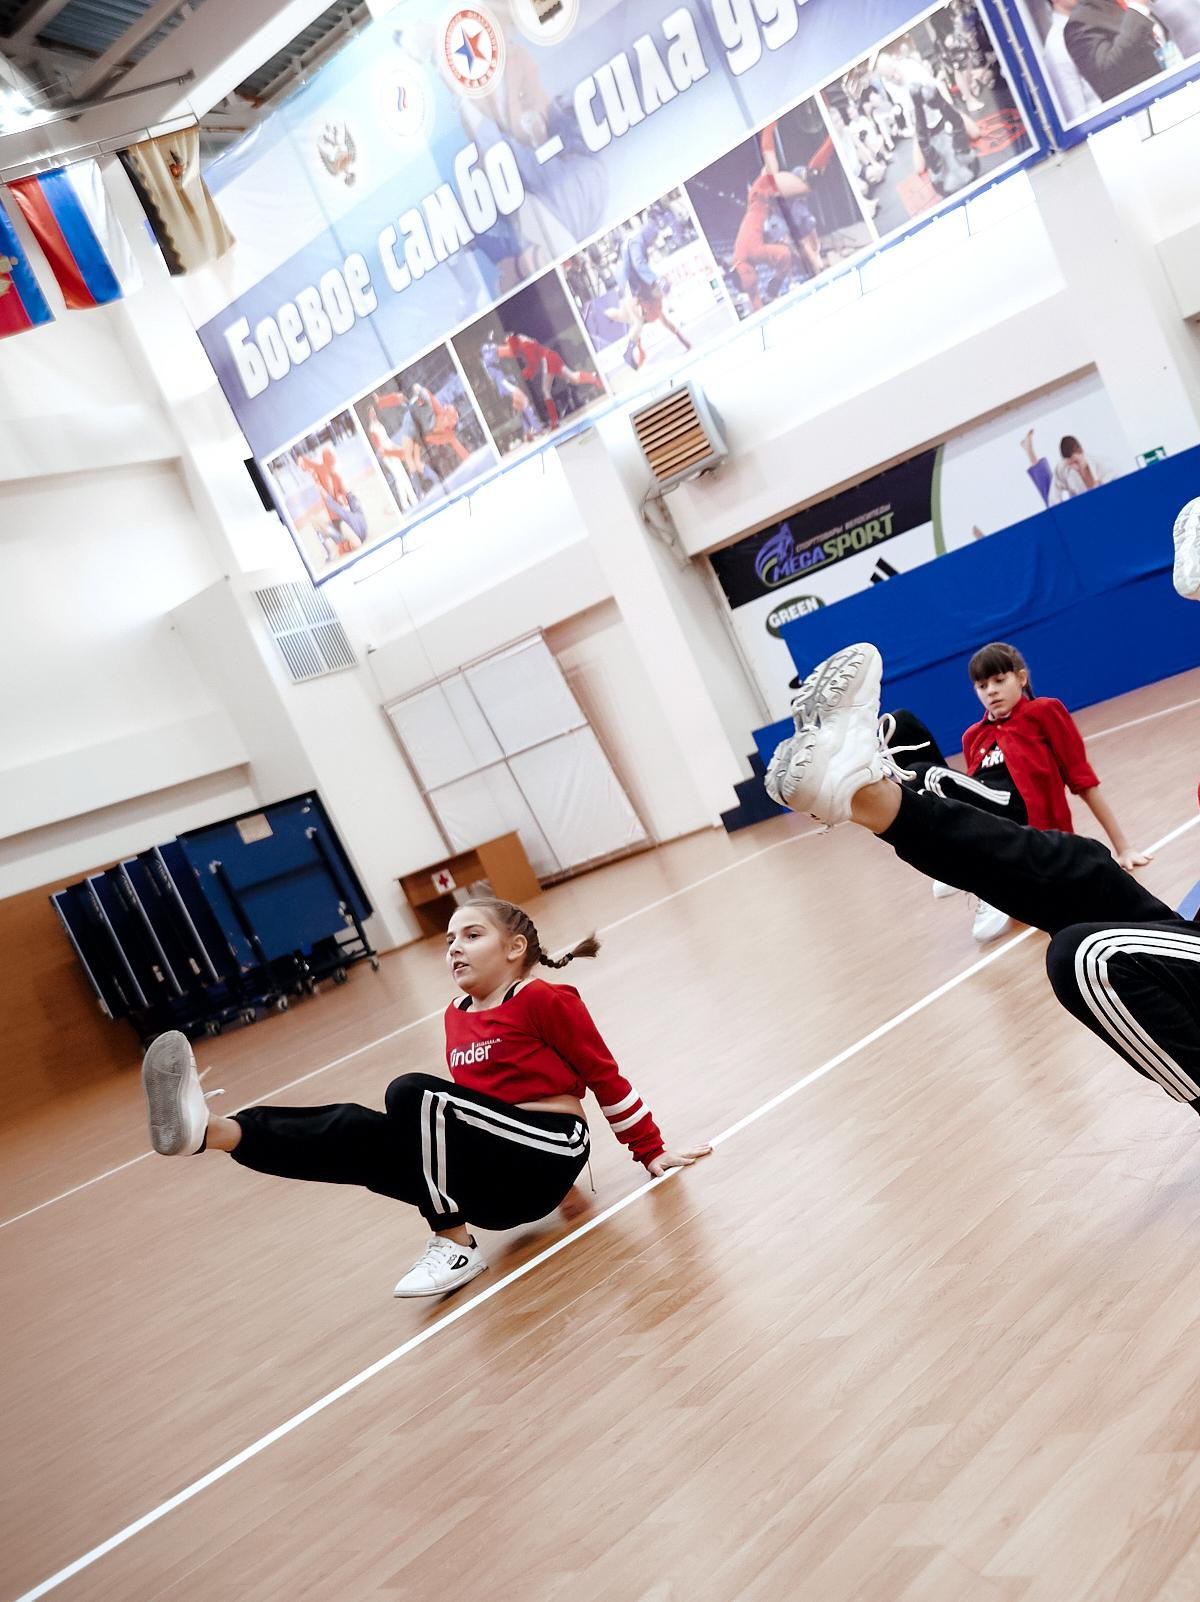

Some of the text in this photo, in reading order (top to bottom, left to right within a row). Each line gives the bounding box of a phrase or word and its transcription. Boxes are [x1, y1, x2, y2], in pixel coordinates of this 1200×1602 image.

[224, 252, 378, 399] Боевое
[378, 140, 525, 292] самбо
[574, 7, 710, 152] сила
[773, 511, 895, 582] MEGASPORT
[768, 597, 819, 628] GREEN
